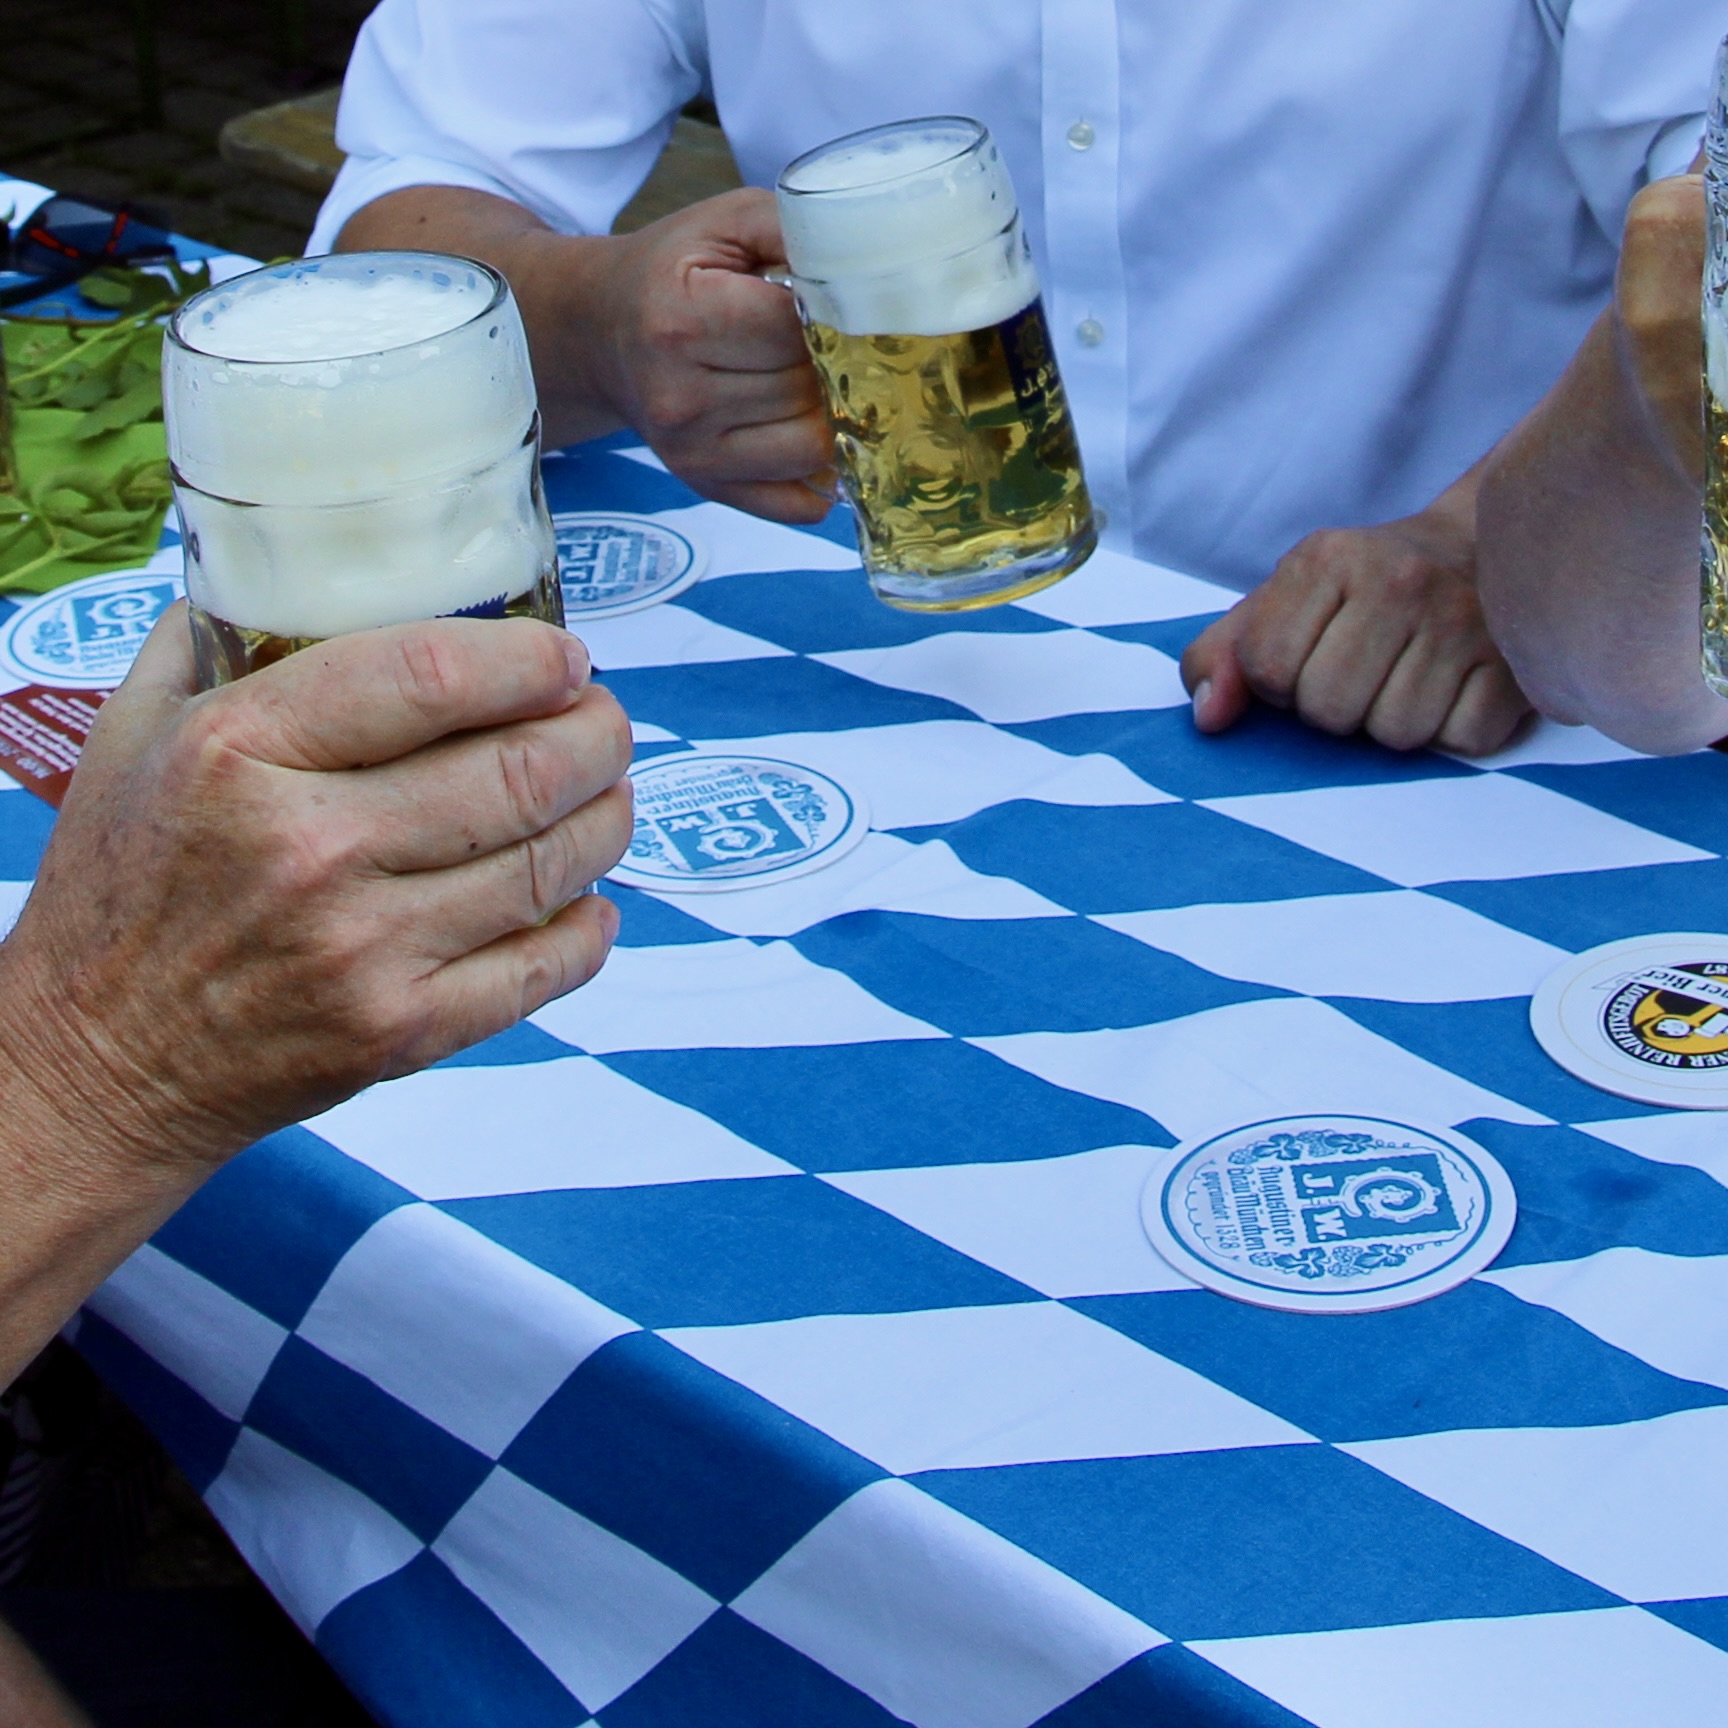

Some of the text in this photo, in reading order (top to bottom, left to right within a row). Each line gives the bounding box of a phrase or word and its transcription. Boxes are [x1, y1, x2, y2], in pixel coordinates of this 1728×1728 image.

[1642, 969, 1693, 990] Bier
[1227, 1166, 1270, 1252] Bräu München
[1302, 1173, 1348, 1241] J. W.
[1215, 1223, 1241, 1250] 1328
